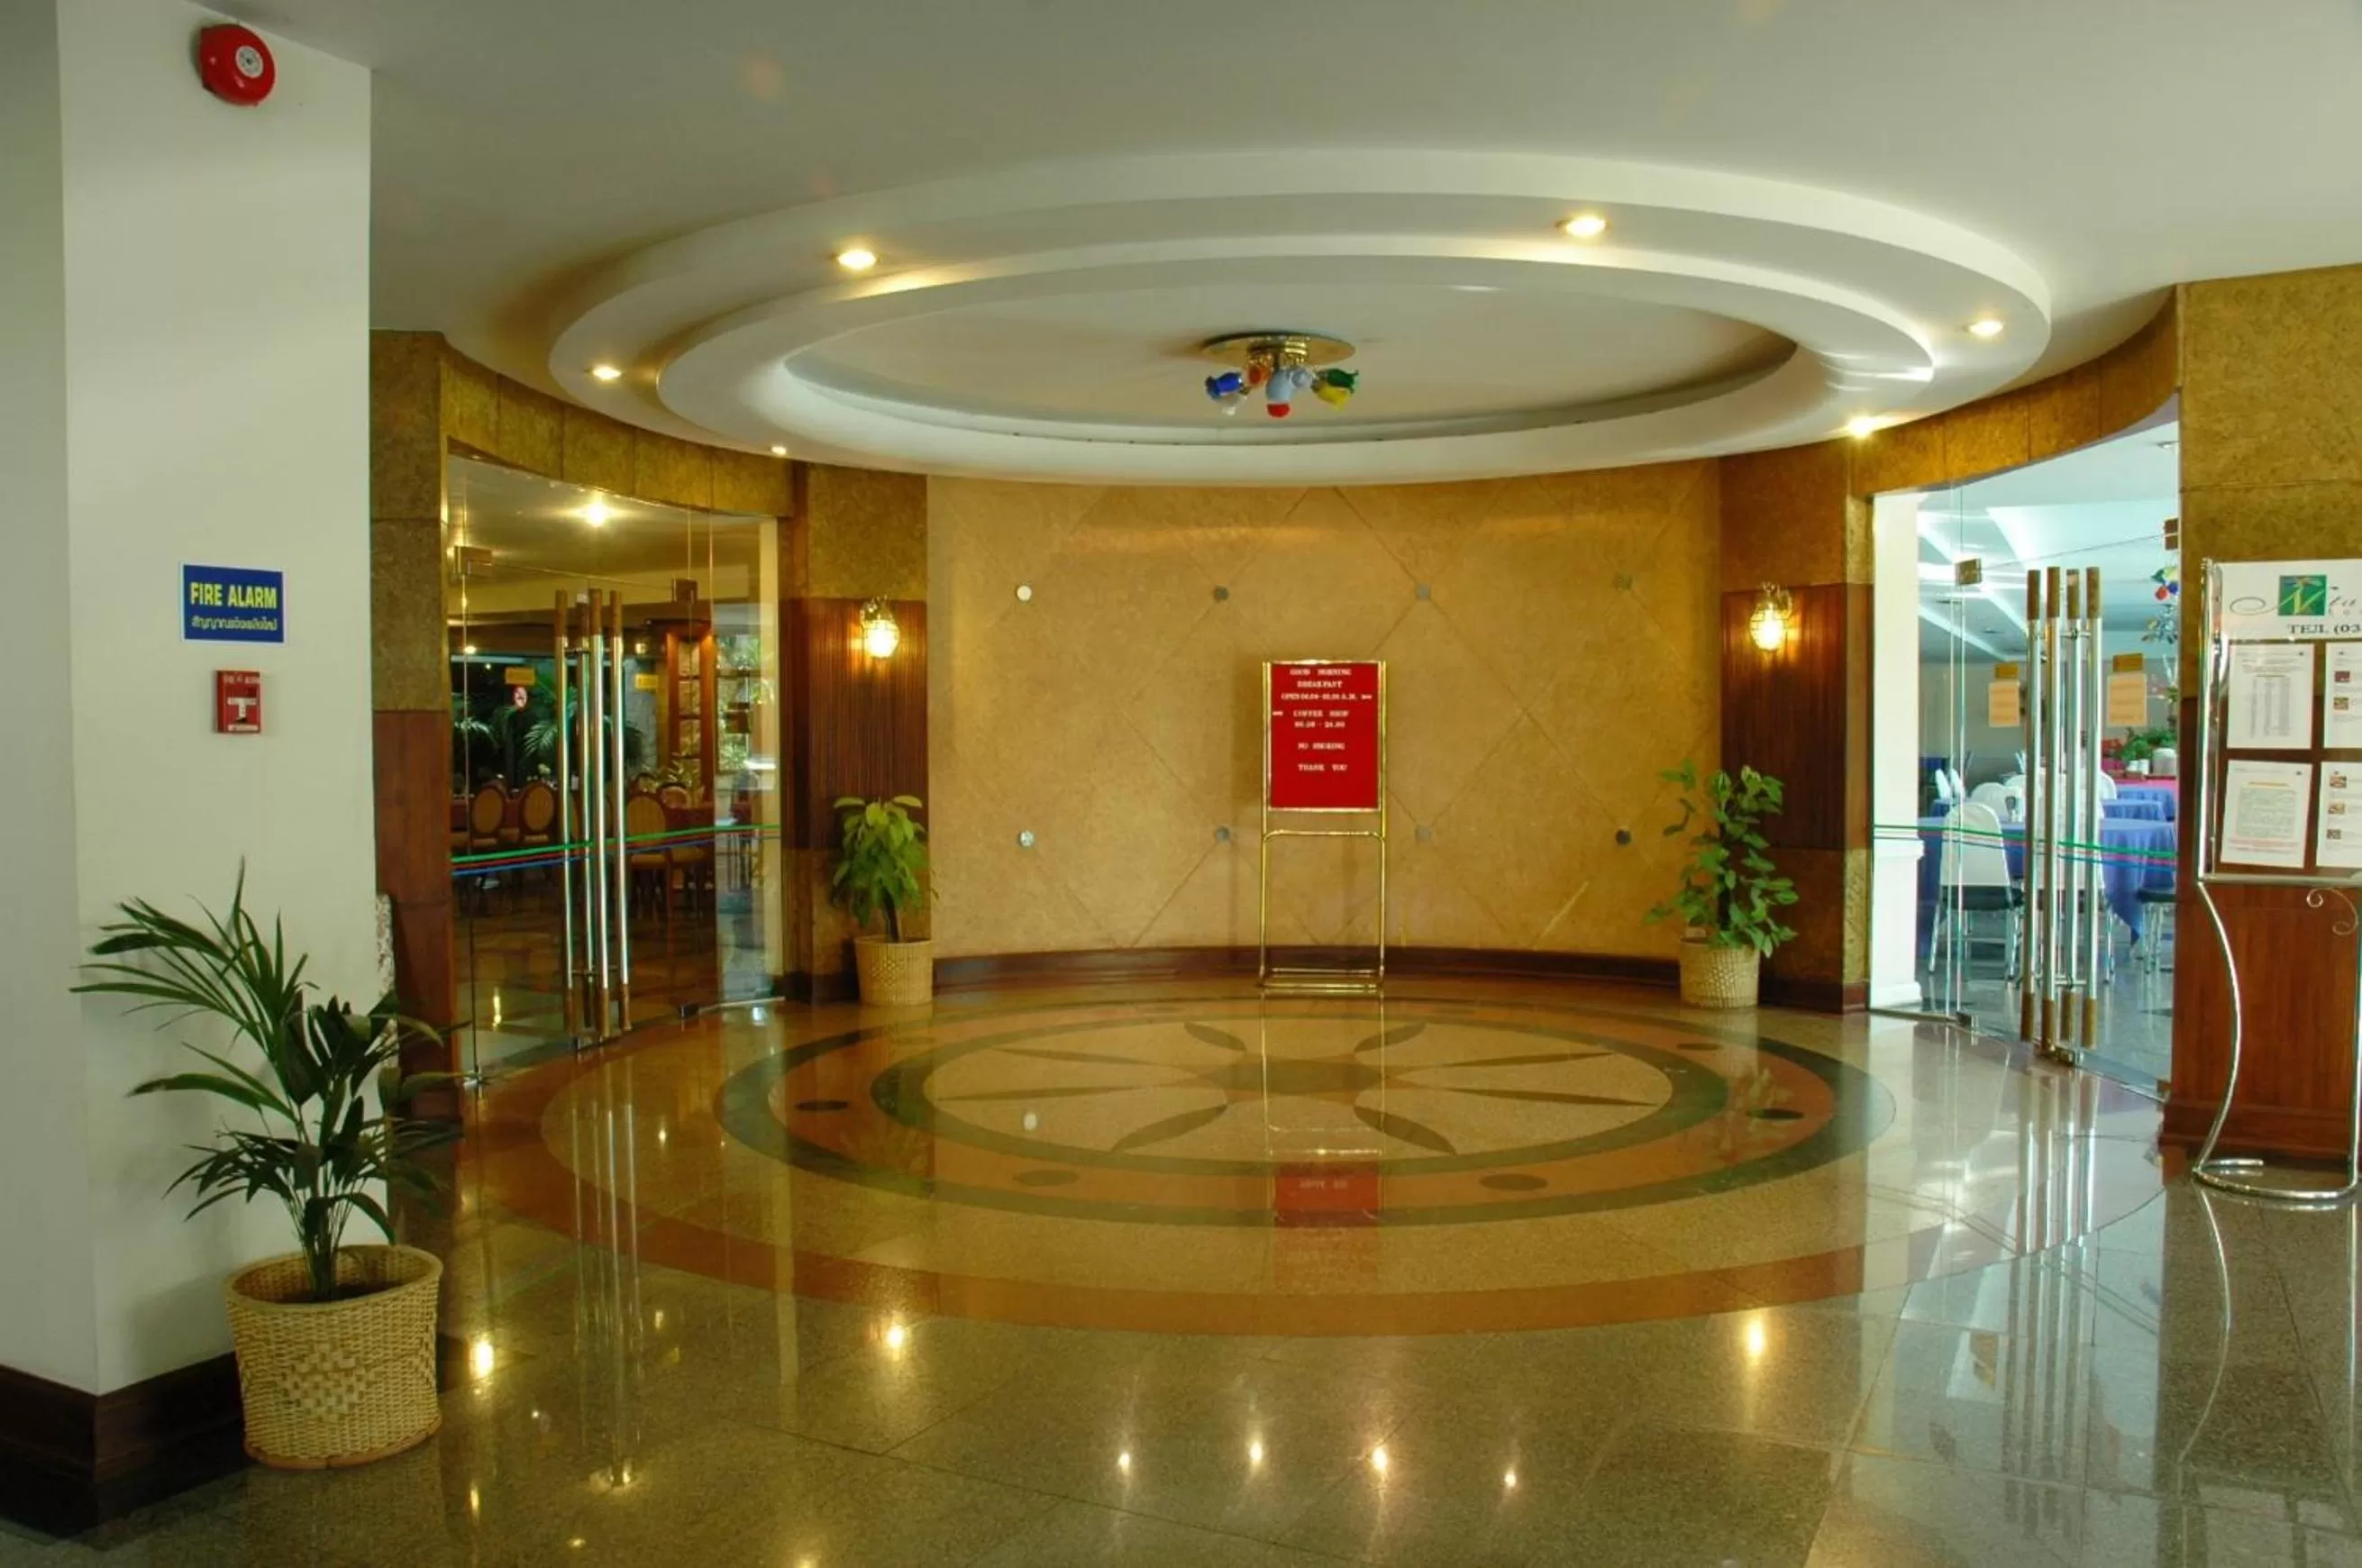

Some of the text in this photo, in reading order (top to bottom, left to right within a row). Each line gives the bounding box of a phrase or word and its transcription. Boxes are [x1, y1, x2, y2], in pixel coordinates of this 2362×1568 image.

[190, 582, 278, 609] FIRE ALARM
[1298, 763, 1325, 771] THANK
